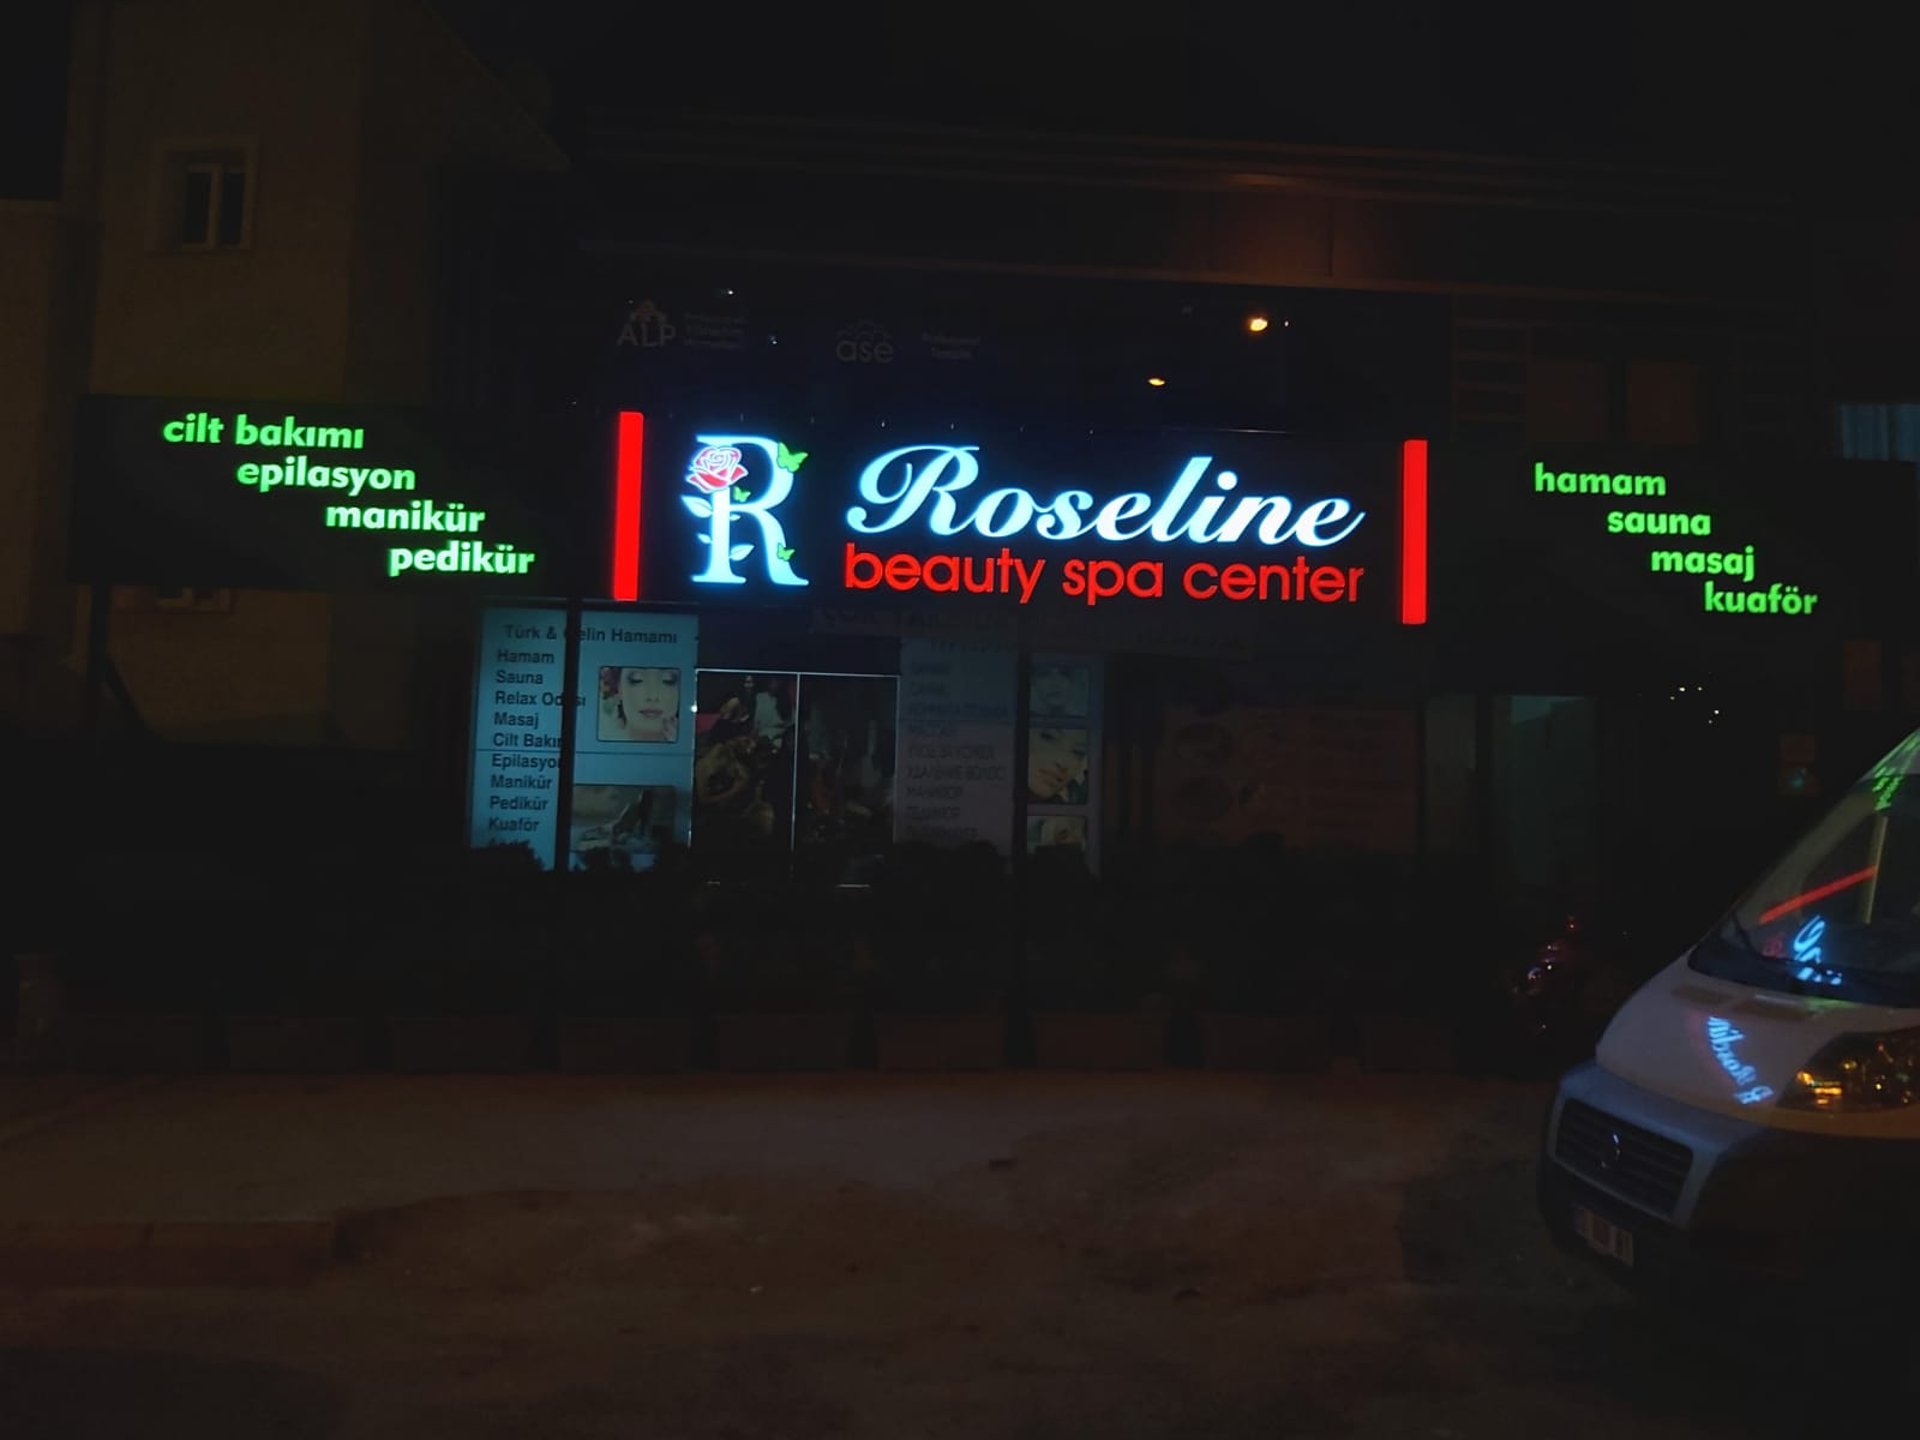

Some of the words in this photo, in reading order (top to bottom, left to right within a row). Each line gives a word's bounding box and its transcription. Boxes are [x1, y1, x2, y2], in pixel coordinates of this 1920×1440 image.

[616, 322, 677, 347] ALP
[836, 340, 894, 363] ase
[163, 412, 224, 443] cilt
[235, 414, 365, 449] bakımı
[236, 455, 416, 496] epilasyon
[1535, 462, 1666, 496] hamam
[846, 444, 1366, 547] Roseline
[325, 500, 486, 532] manikür
[1607, 511, 1711, 535] sauna
[389, 540, 535, 577] pedikür
[1651, 545, 1755, 582] masaj
[844, 543, 1046, 603] beauty
[1062, 558, 1164, 606] spa
[1183, 556, 1366, 603] center
[1704, 581, 1818, 614] kuaför
[504, 624, 541, 640] Türk
[547, 627, 557, 640] &
[564, 627, 606, 642] elin
[611, 628, 678, 644] Hamamı
[497, 649, 555, 664] Hamam
[495, 669, 544, 685] Sauna
[494, 690, 538, 706] Relax
[494, 712, 539, 730] Masaj
[493, 732, 519, 748] Cilt
[490, 773, 553, 790] Manikür
[489, 795, 549, 811] Pedikür
[488, 816, 540, 832] Kuaför
